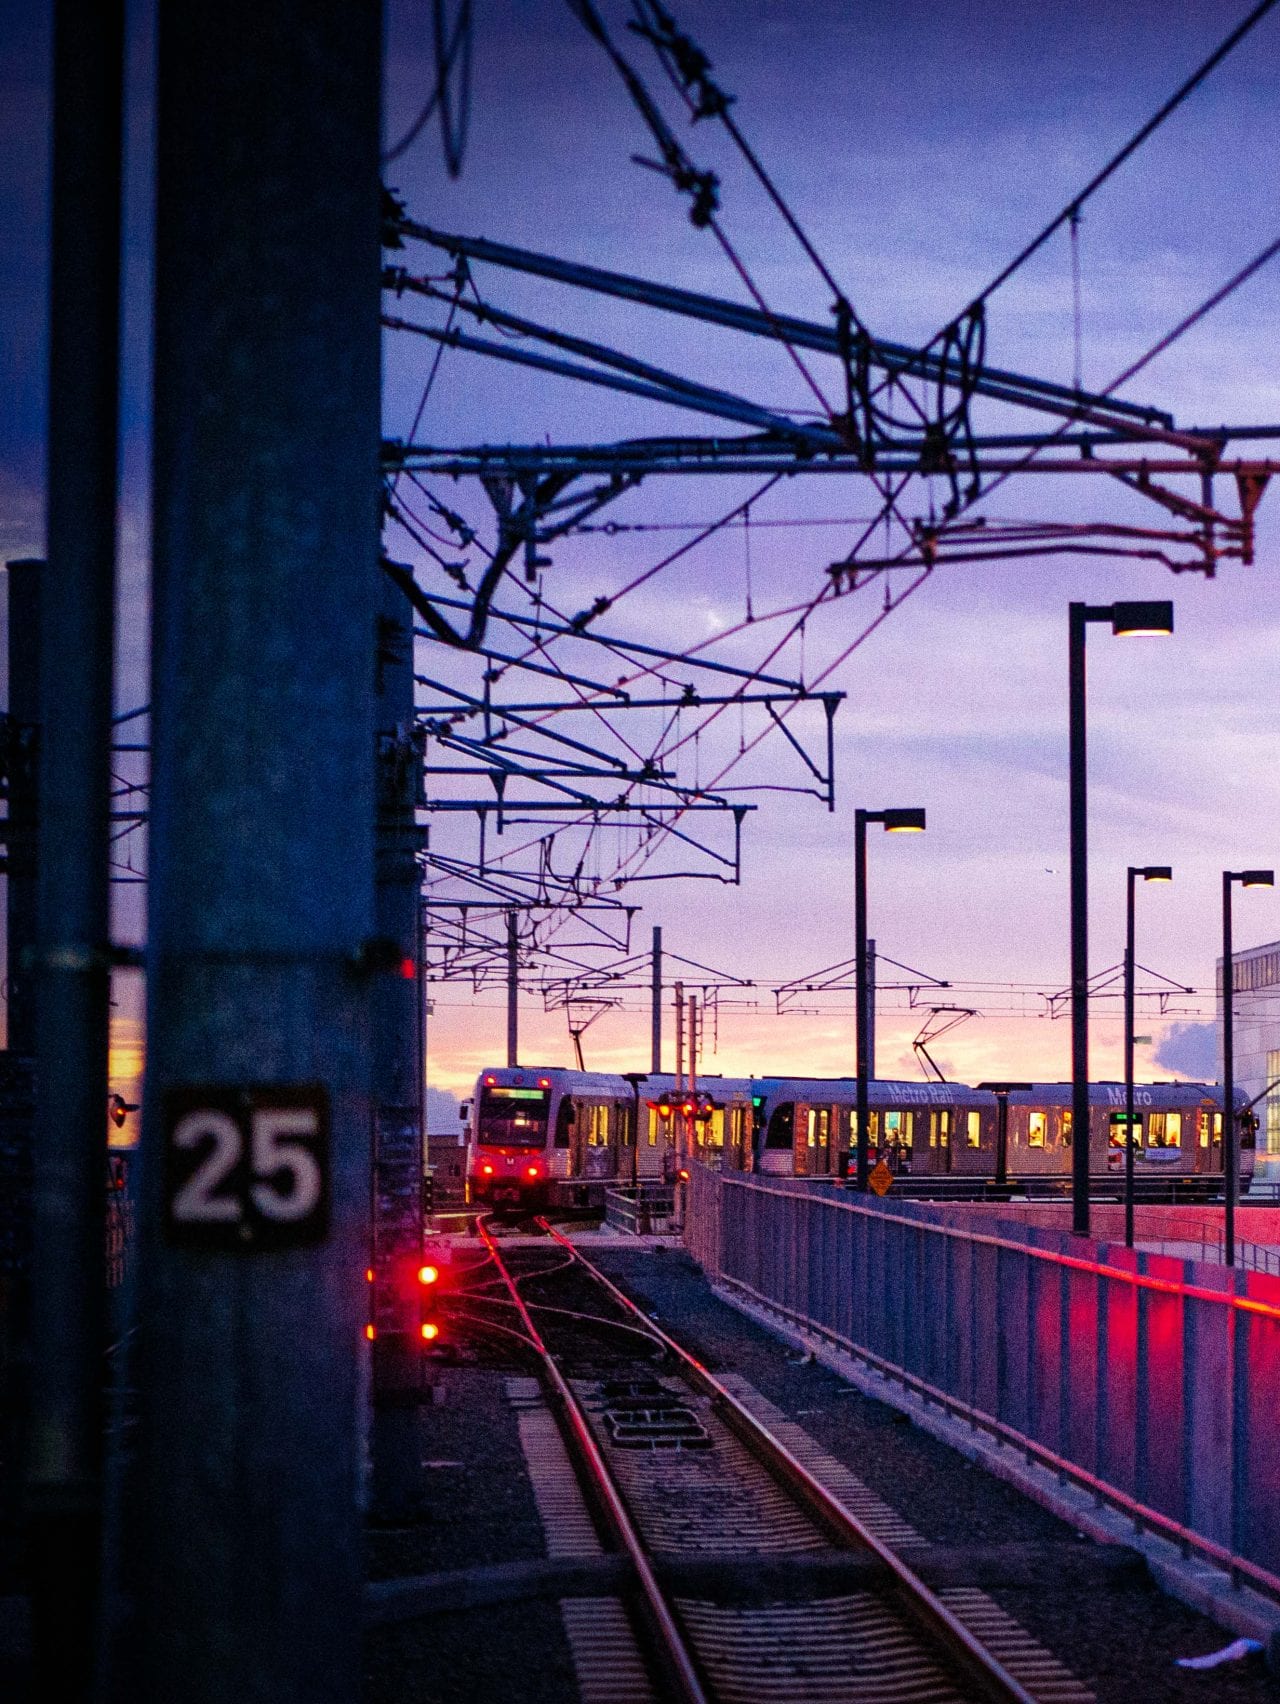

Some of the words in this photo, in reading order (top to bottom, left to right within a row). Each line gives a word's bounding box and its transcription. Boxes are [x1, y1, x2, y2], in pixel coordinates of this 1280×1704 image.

[888, 1084, 928, 1103] Metro
[928, 1085, 954, 1103] Rail
[173, 1110, 321, 1221] 25
